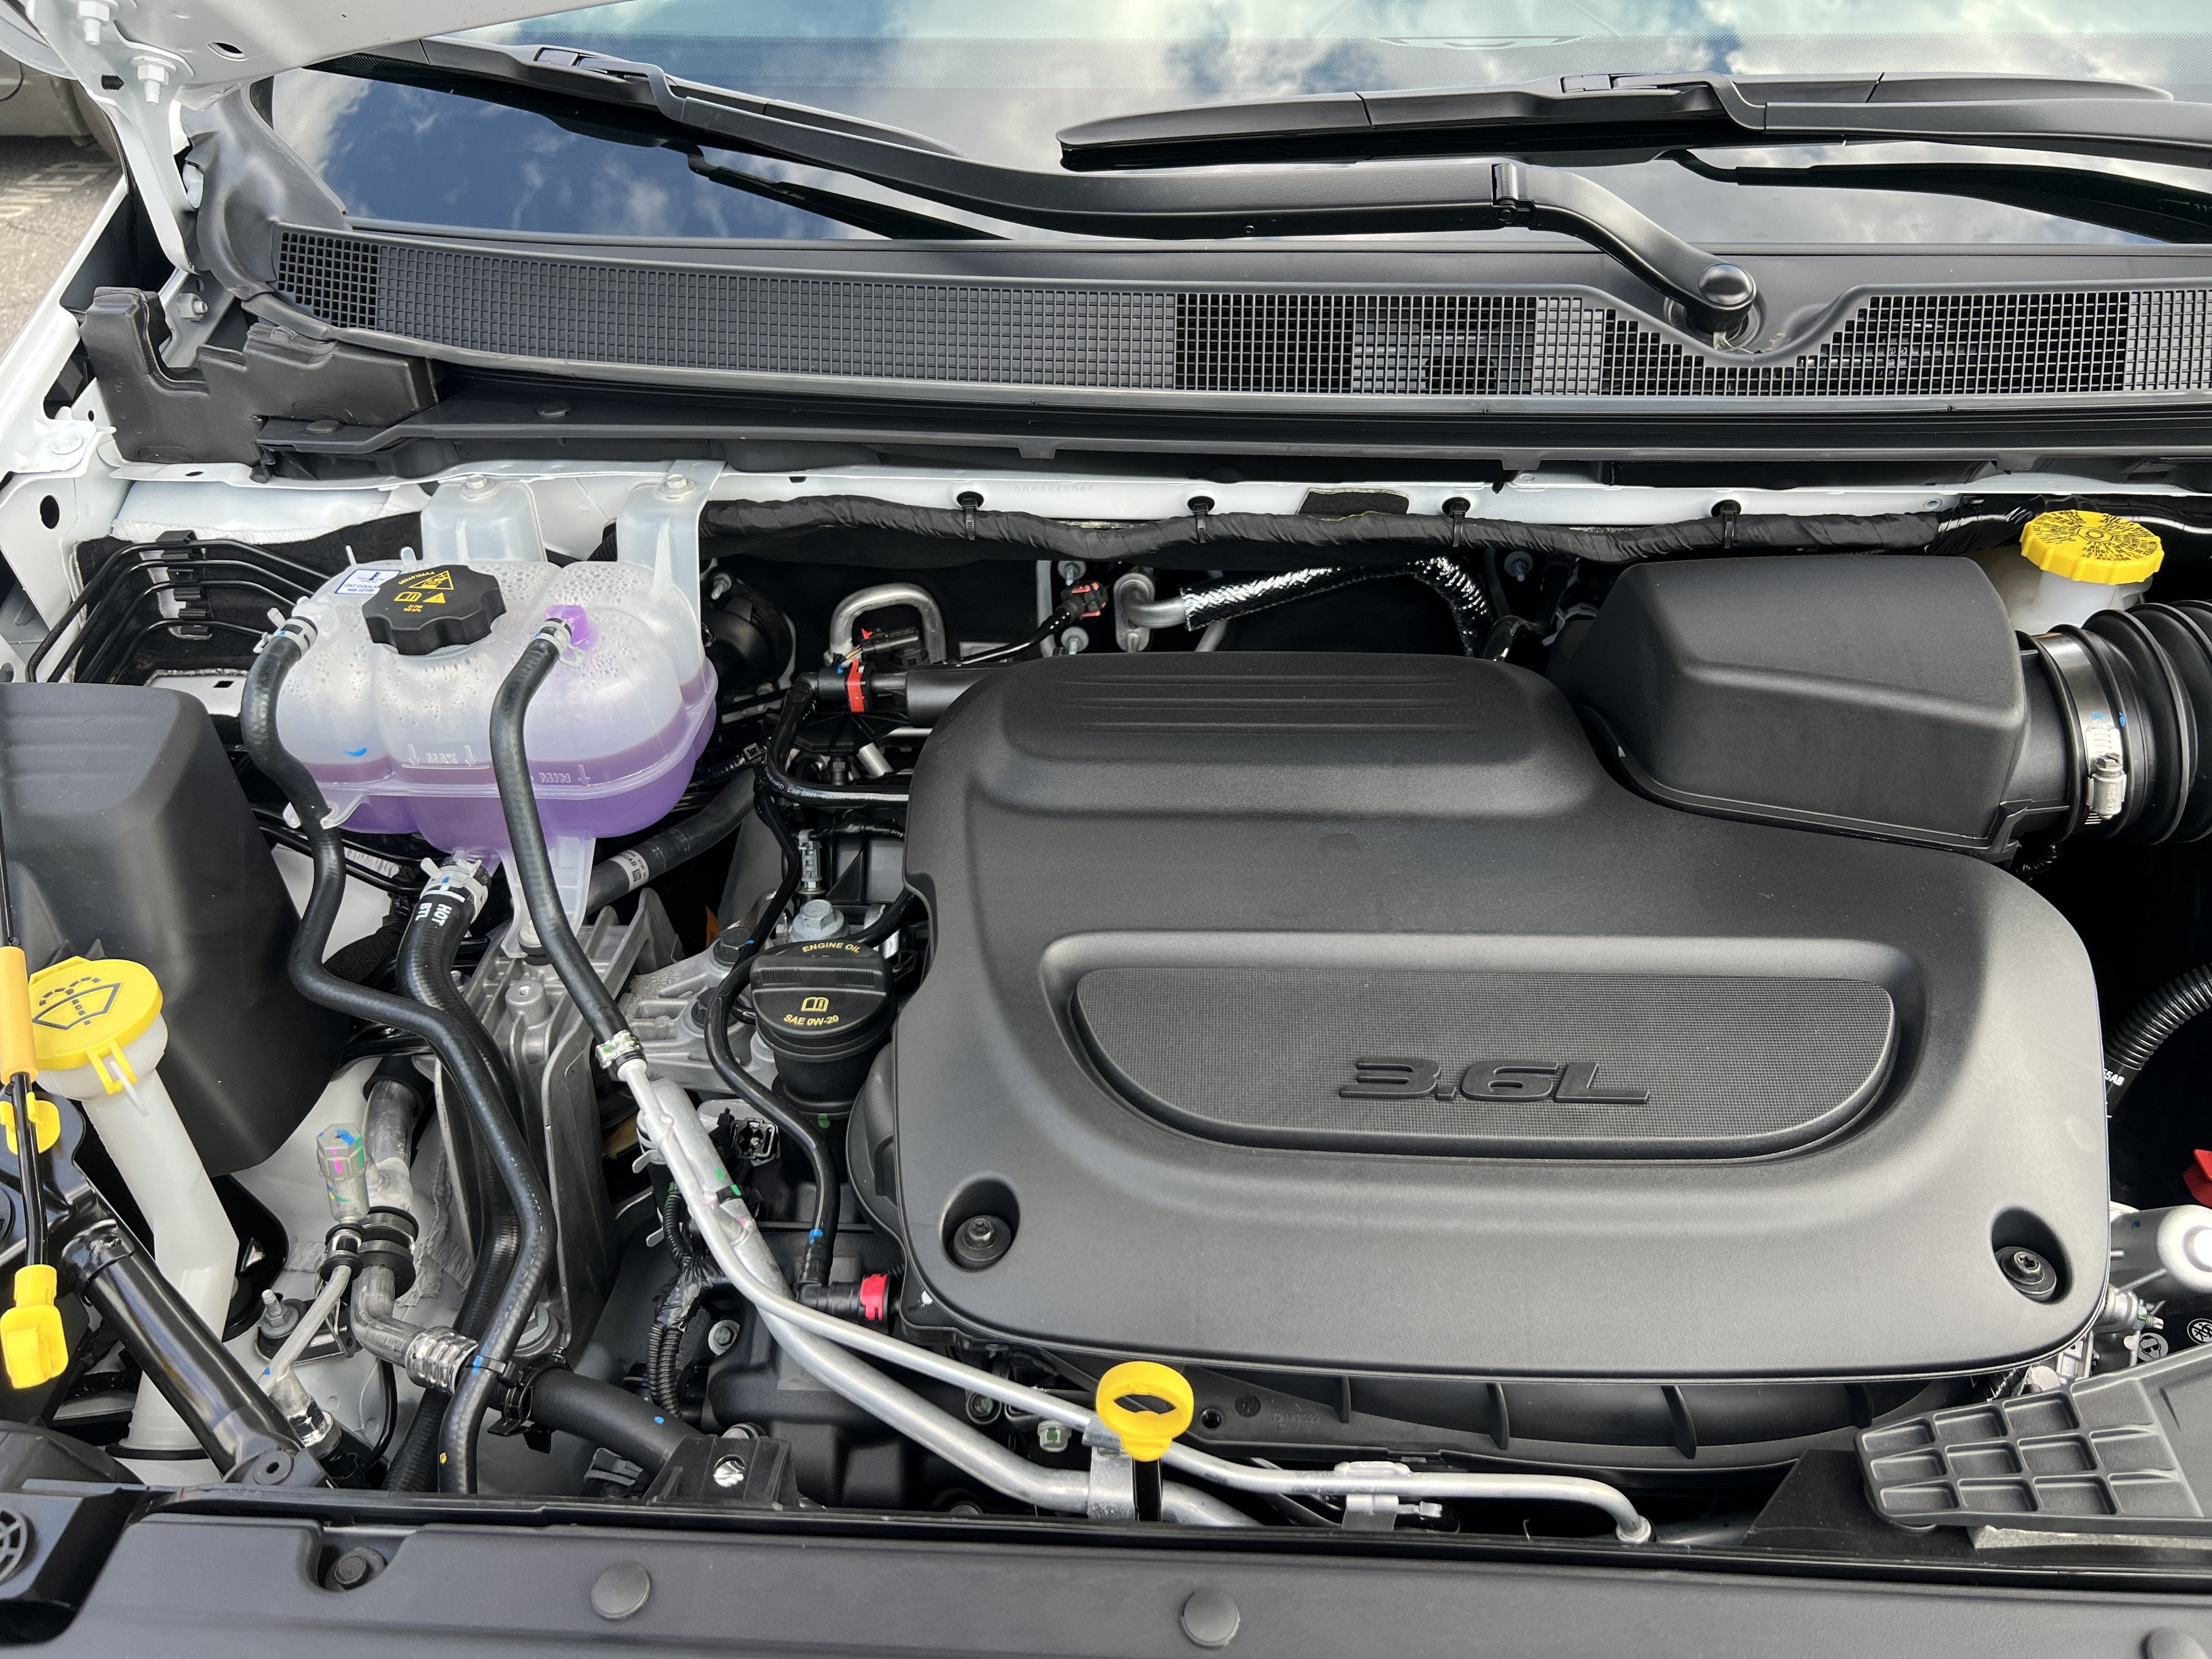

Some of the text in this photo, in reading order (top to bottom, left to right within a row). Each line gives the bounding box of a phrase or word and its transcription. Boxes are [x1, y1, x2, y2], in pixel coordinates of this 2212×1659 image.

[425, 752, 458, 764] MAX
[538, 771, 572, 783] MIN
[415, 902, 433, 921] BTL
[431, 903, 453, 927] HOT
[802, 942, 861, 954] ENGINE OIL
[783, 1014, 840, 1026] SAE 0W-20
[1339, 1058, 1650, 1103] 3.6L
